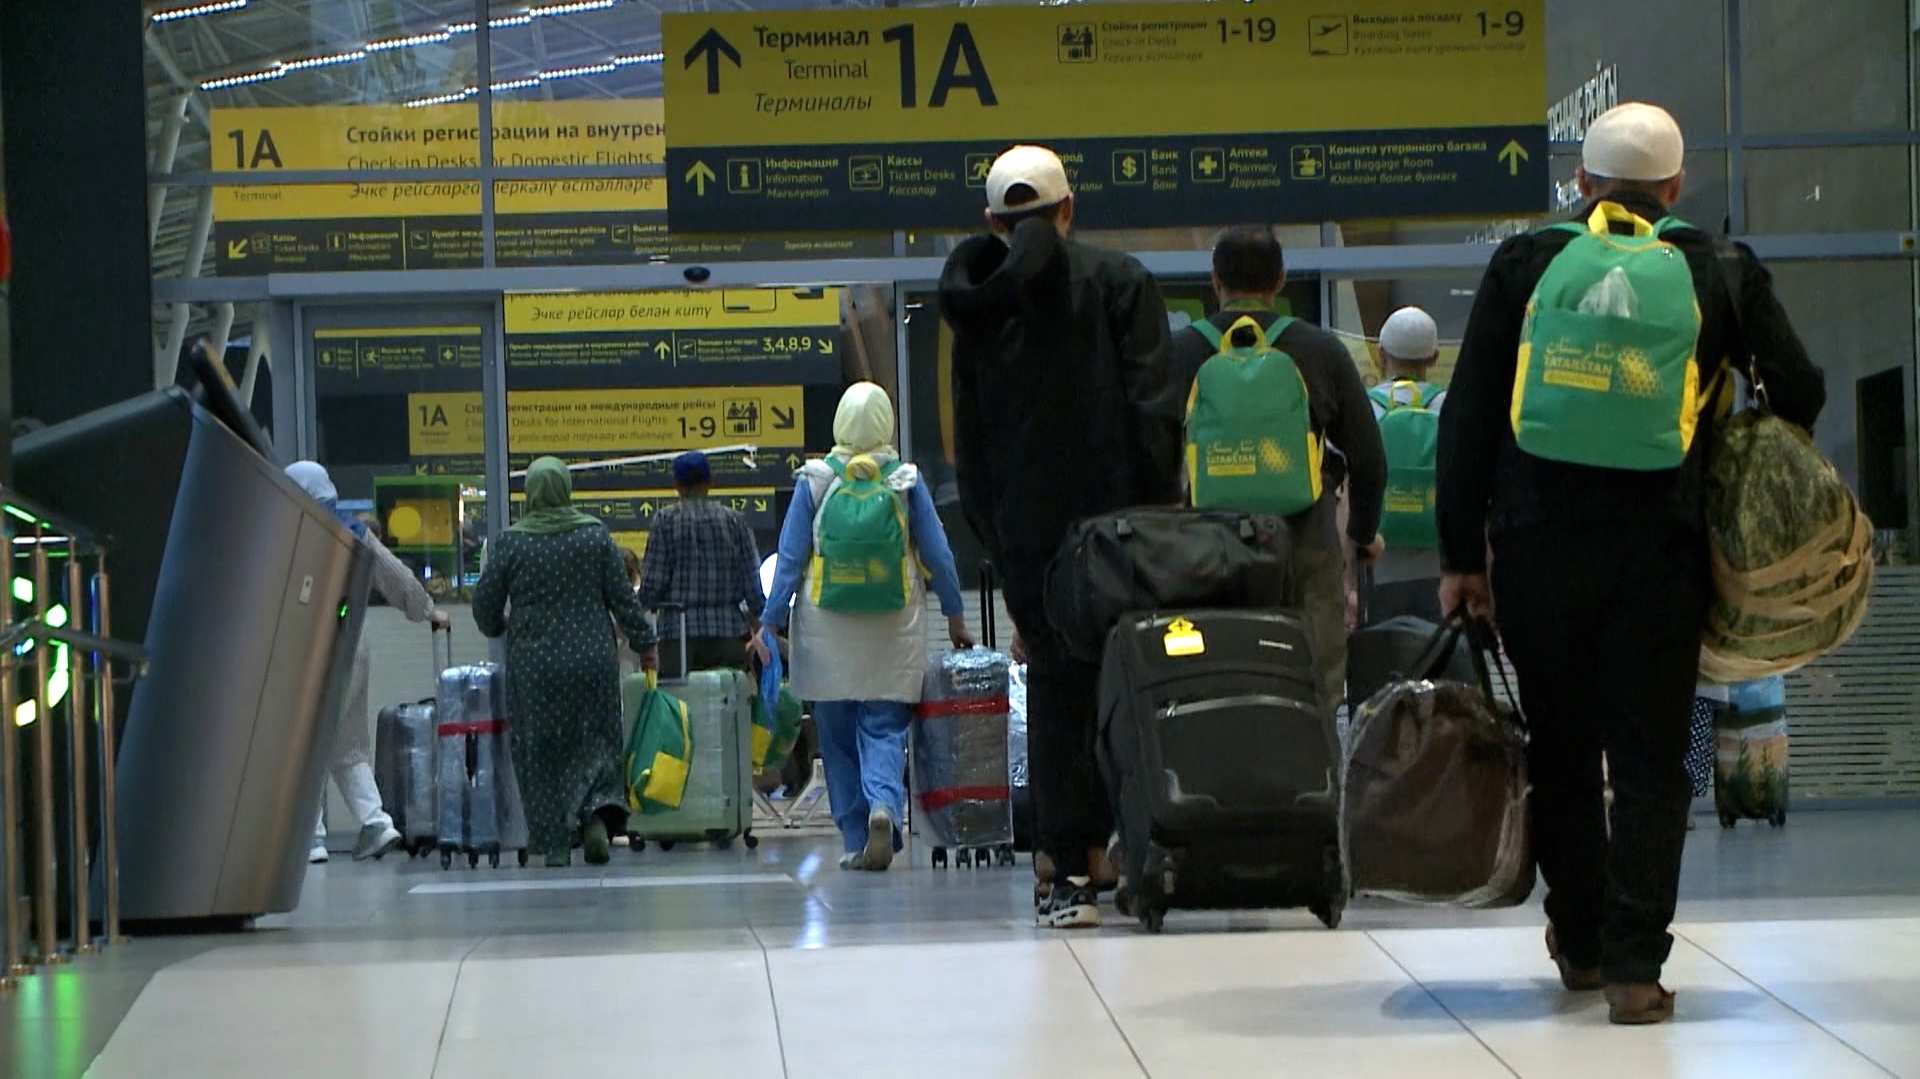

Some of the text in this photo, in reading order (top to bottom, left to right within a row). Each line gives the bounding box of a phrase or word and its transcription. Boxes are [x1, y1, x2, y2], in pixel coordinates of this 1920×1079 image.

[1217, 17, 1276, 43] 1-19
[1476, 11, 1524, 37] 1-9
[754, 25, 869, 51] Терминал
[785, 59, 868, 79] Terminal
[882, 22, 998, 107] 1A
[755, 94, 871, 115] Терминалы
[347, 126, 416, 143] Стойки
[423, 125, 549, 145] регисрации
[557, 126, 579, 138] на
[228, 129, 283, 169] 1A
[1152, 150, 1178, 160] Банк
[1229, 148, 1268, 158] Аптека
[1330, 141, 1487, 155] Комната утерянного багажа
[347, 155, 420, 170] Check-in
[427, 154, 477, 168] Desks
[511, 152, 589, 167] Domestic
[765, 157, 839, 171] Информация
[887, 155, 922, 166] Кассы
[1229, 162, 1277, 174] Pharmacy
[1330, 158, 1433, 170] Lost Baggage Room
[890, 169, 955, 181] Ticket Desks
[1152, 165, 1177, 175] Bank
[766, 174, 822, 184] Information
[233, 190, 282, 200] Terminal
[349, 183, 387, 198] Эчке
[532, 307, 563, 321] Эчке
[568, 306, 625, 322] рейслар
[629, 304, 670, 317] белән
[763, 336, 811, 353] 3,4,8,9
[1543, 355, 1613, 374] TATARSTAN
[575, 404, 587, 412] на
[590, 401, 679, 412] международные
[419, 404, 448, 427] 1A
[677, 416, 716, 439] 1-9
